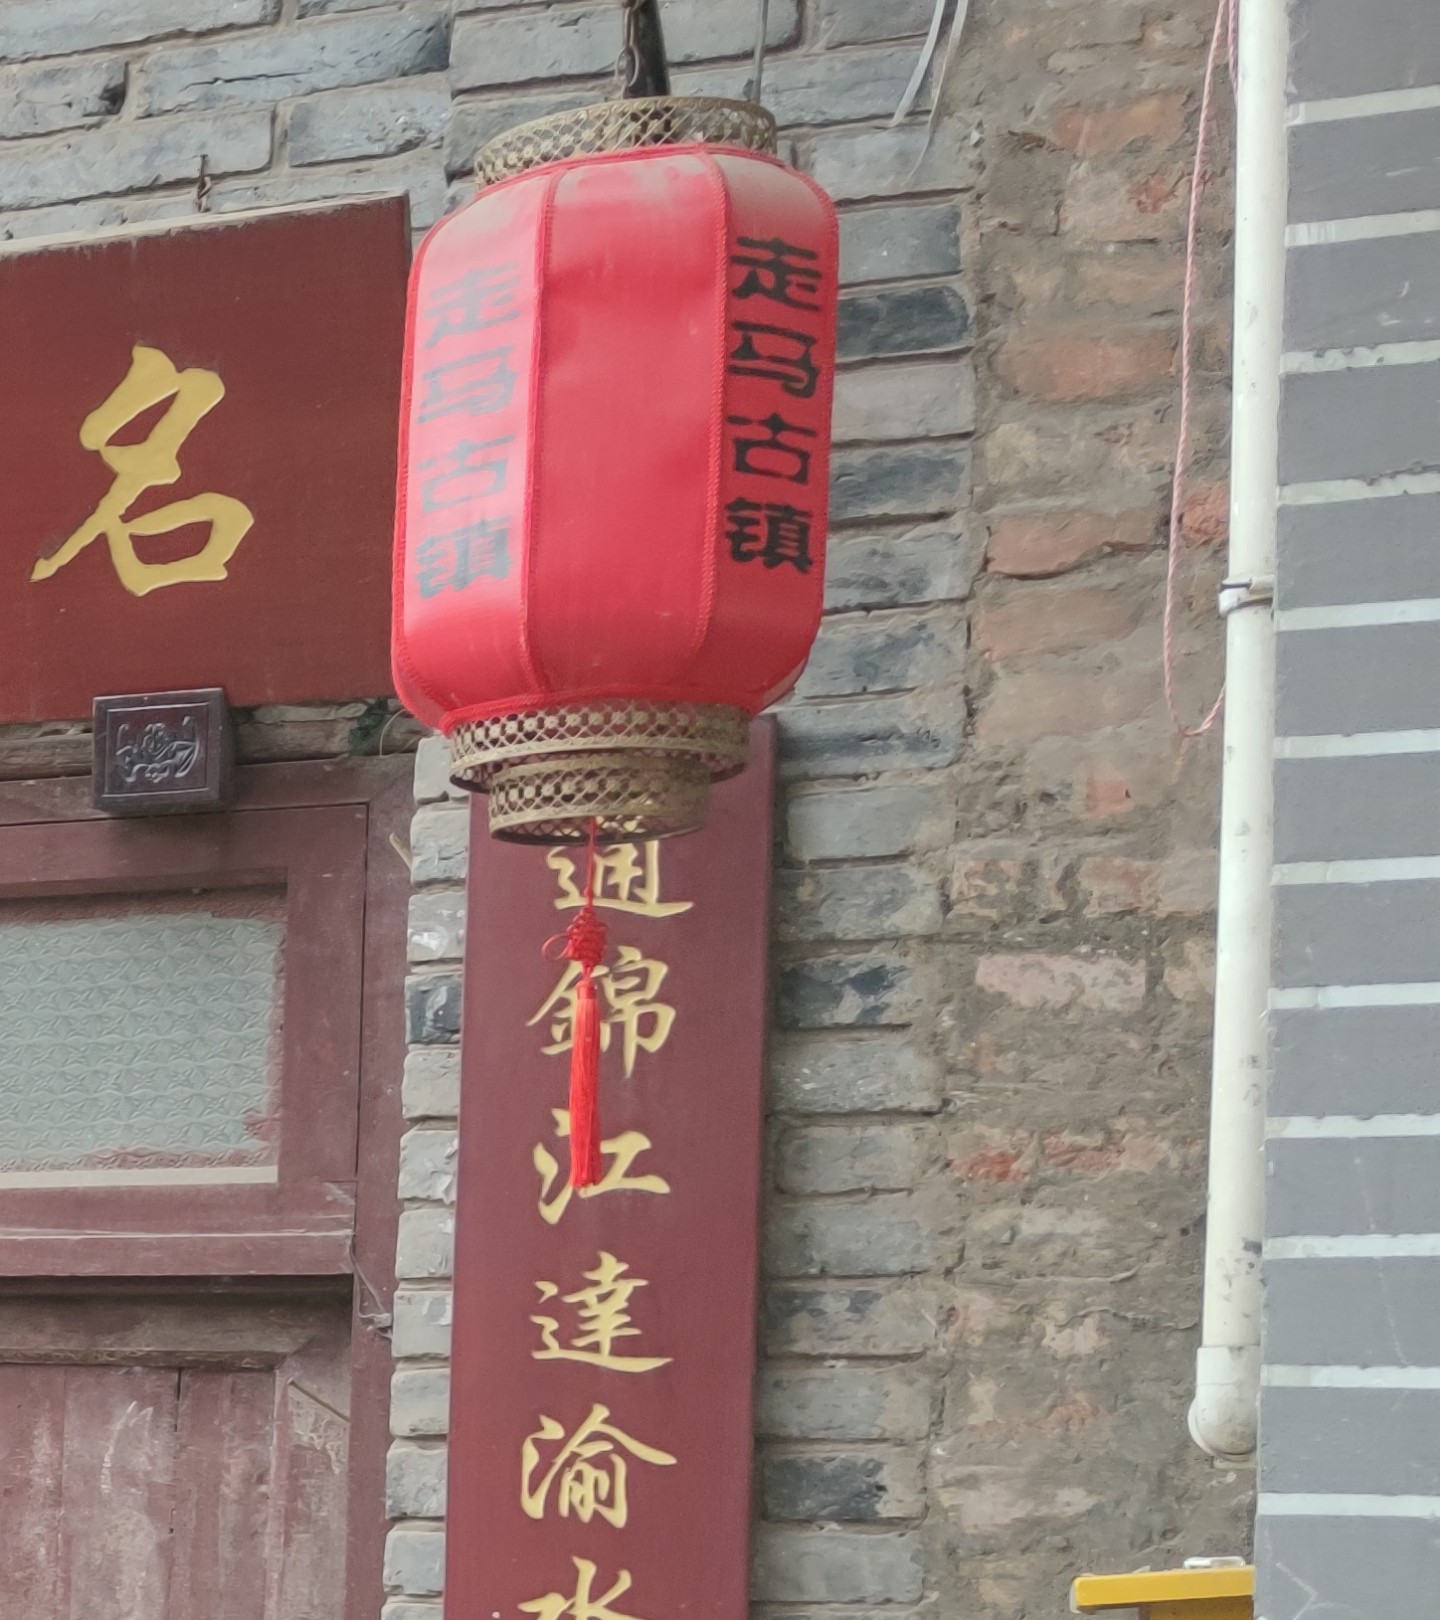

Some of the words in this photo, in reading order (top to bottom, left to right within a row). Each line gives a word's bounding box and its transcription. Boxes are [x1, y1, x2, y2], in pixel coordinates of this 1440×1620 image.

[413, 256, 521, 602] 走马古镇
[725, 236, 822, 575] 走马古镇
